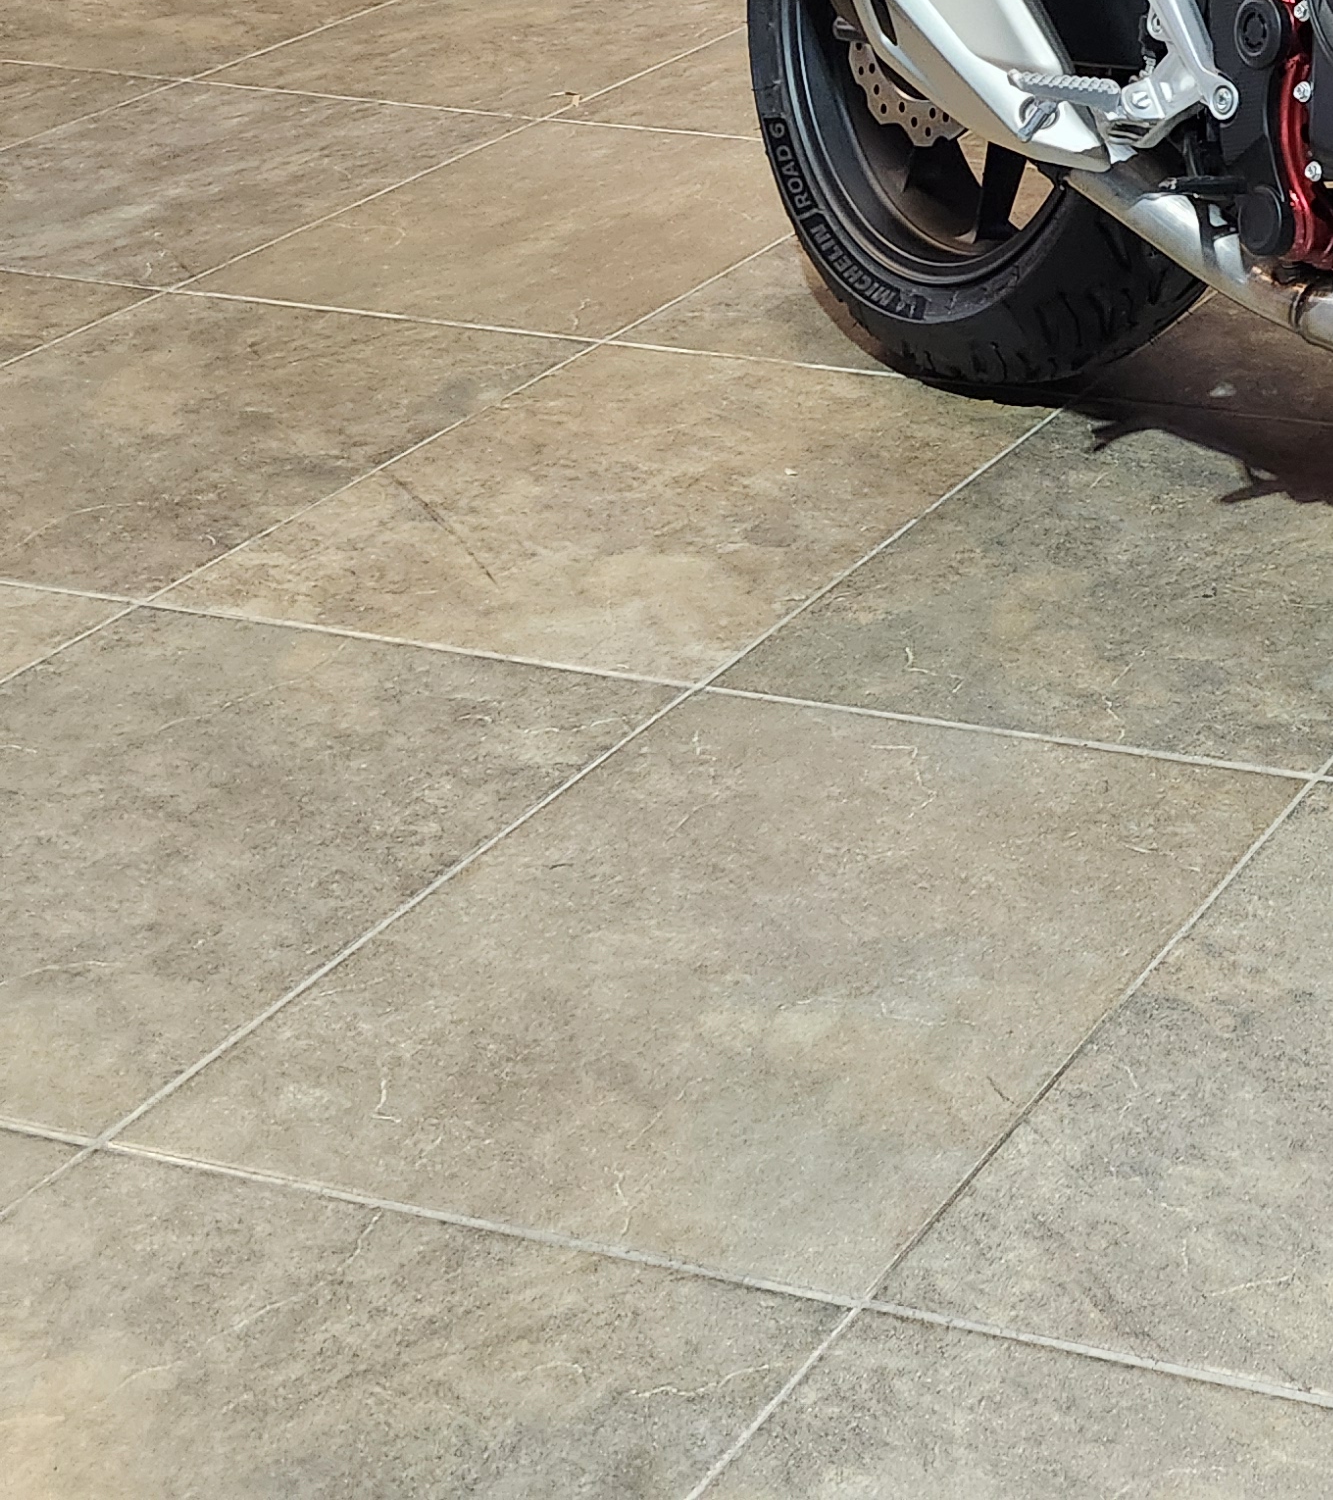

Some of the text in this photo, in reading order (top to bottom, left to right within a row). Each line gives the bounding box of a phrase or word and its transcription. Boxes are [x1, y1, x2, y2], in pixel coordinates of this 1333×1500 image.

[769, 121, 904, 307] MICHELIN ROAD 6
